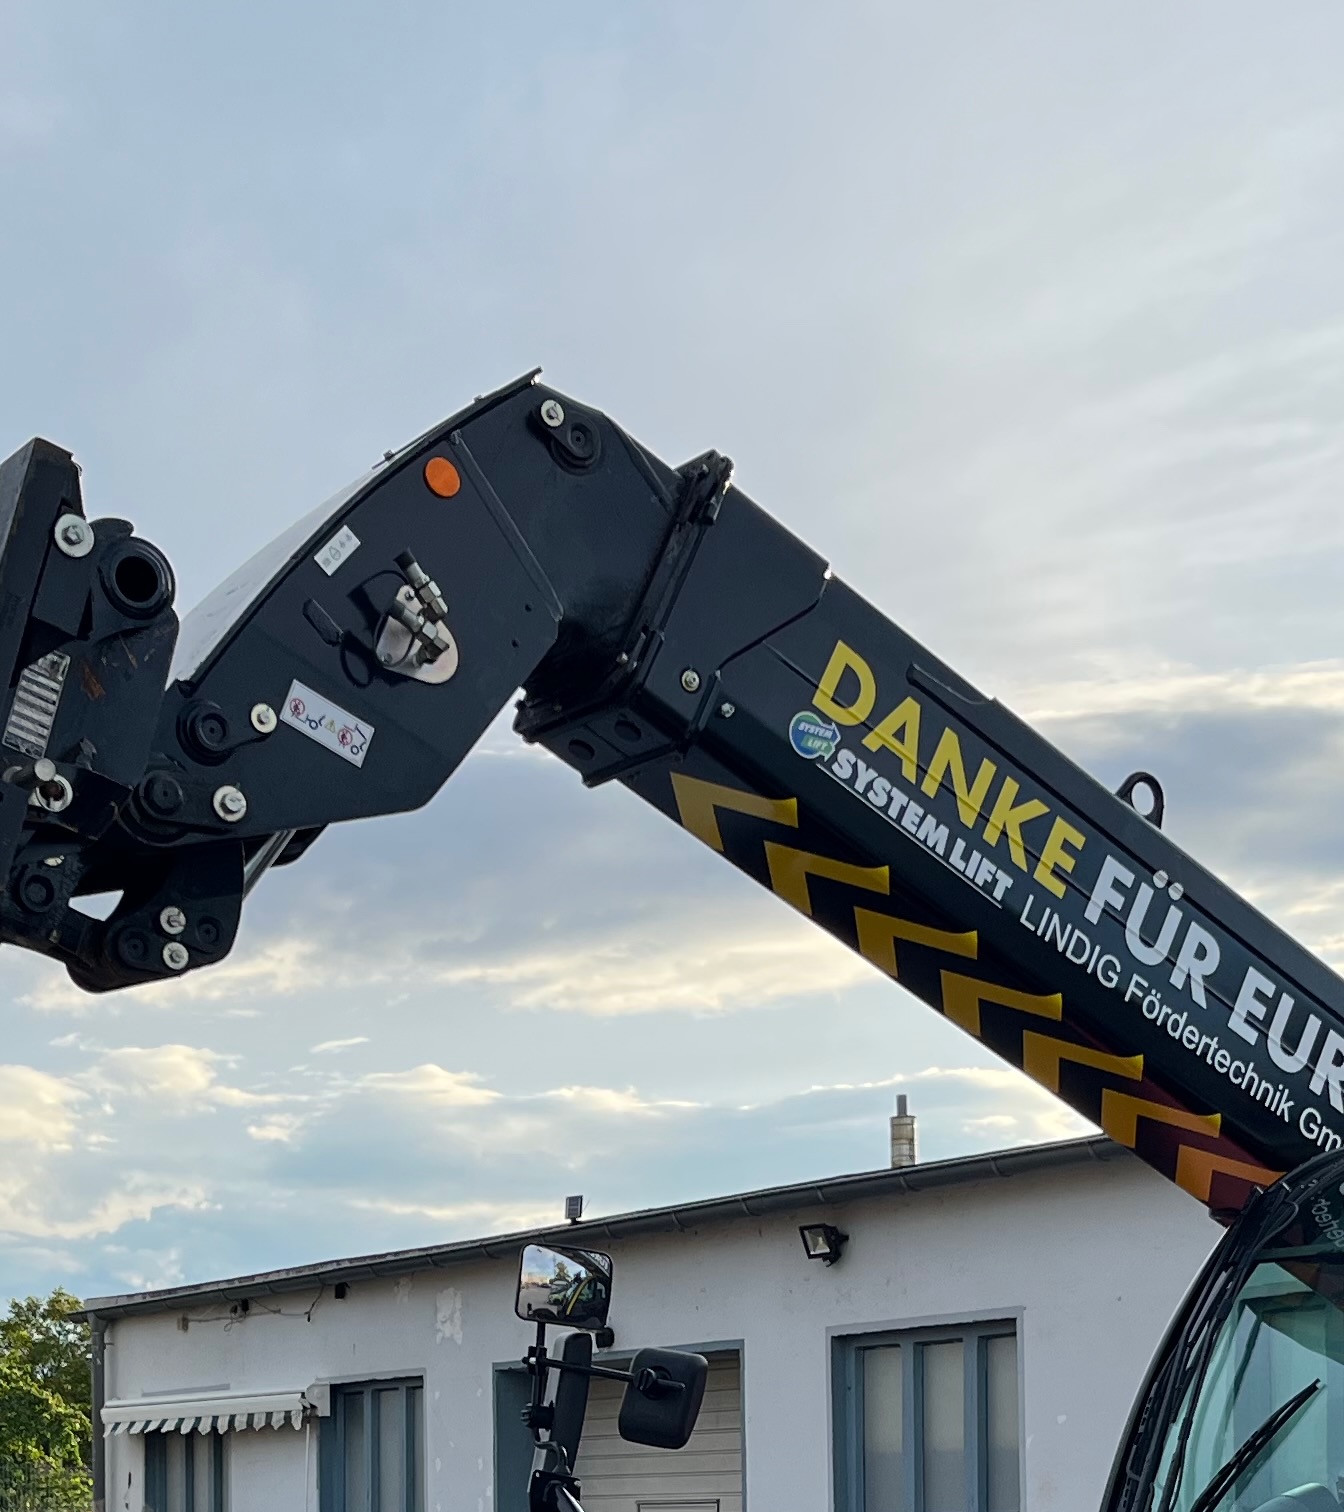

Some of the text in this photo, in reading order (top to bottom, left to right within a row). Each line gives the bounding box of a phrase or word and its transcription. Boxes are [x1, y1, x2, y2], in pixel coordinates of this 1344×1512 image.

[811, 639, 1086, 899] DANKE
[1083, 854, 1221, 1010] FÜR
[831, 748, 950, 857] SYSTEM
[948, 837, 1014, 901] LIFT
[1019, 894, 1121, 990] LINDIG
[1125, 978, 1293, 1124] Fördertechnik
